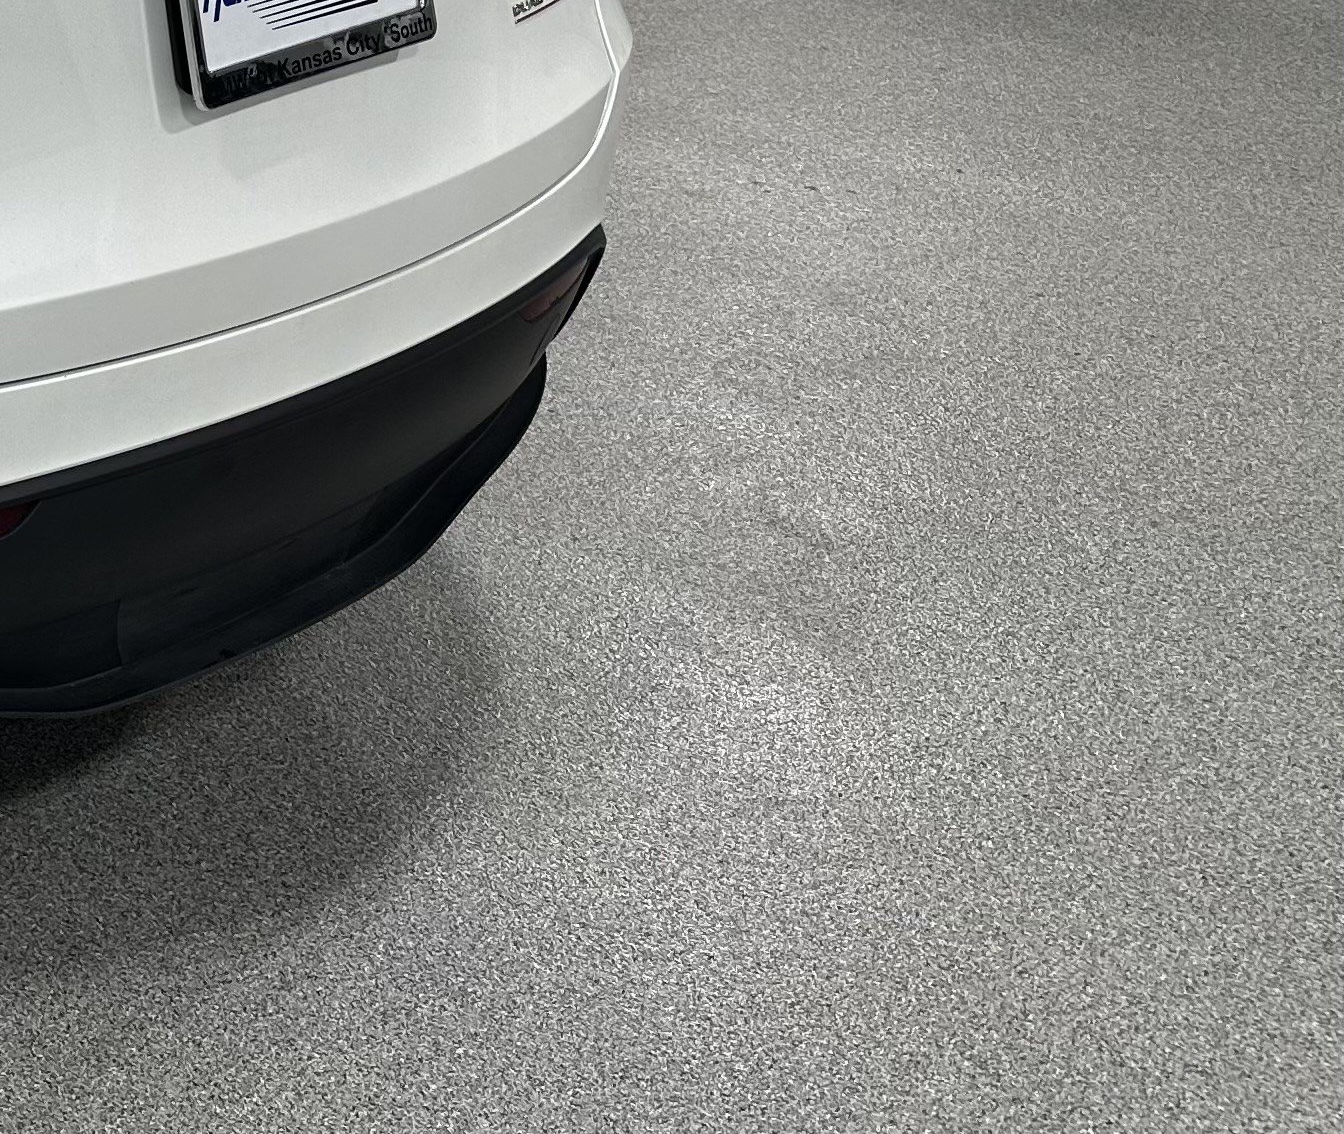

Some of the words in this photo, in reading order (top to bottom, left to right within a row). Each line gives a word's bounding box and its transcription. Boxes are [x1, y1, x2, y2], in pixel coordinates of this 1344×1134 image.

[278, 46, 343, 77] Kansas
[345, 31, 382, 57] City
[389, 16, 434, 43] South
